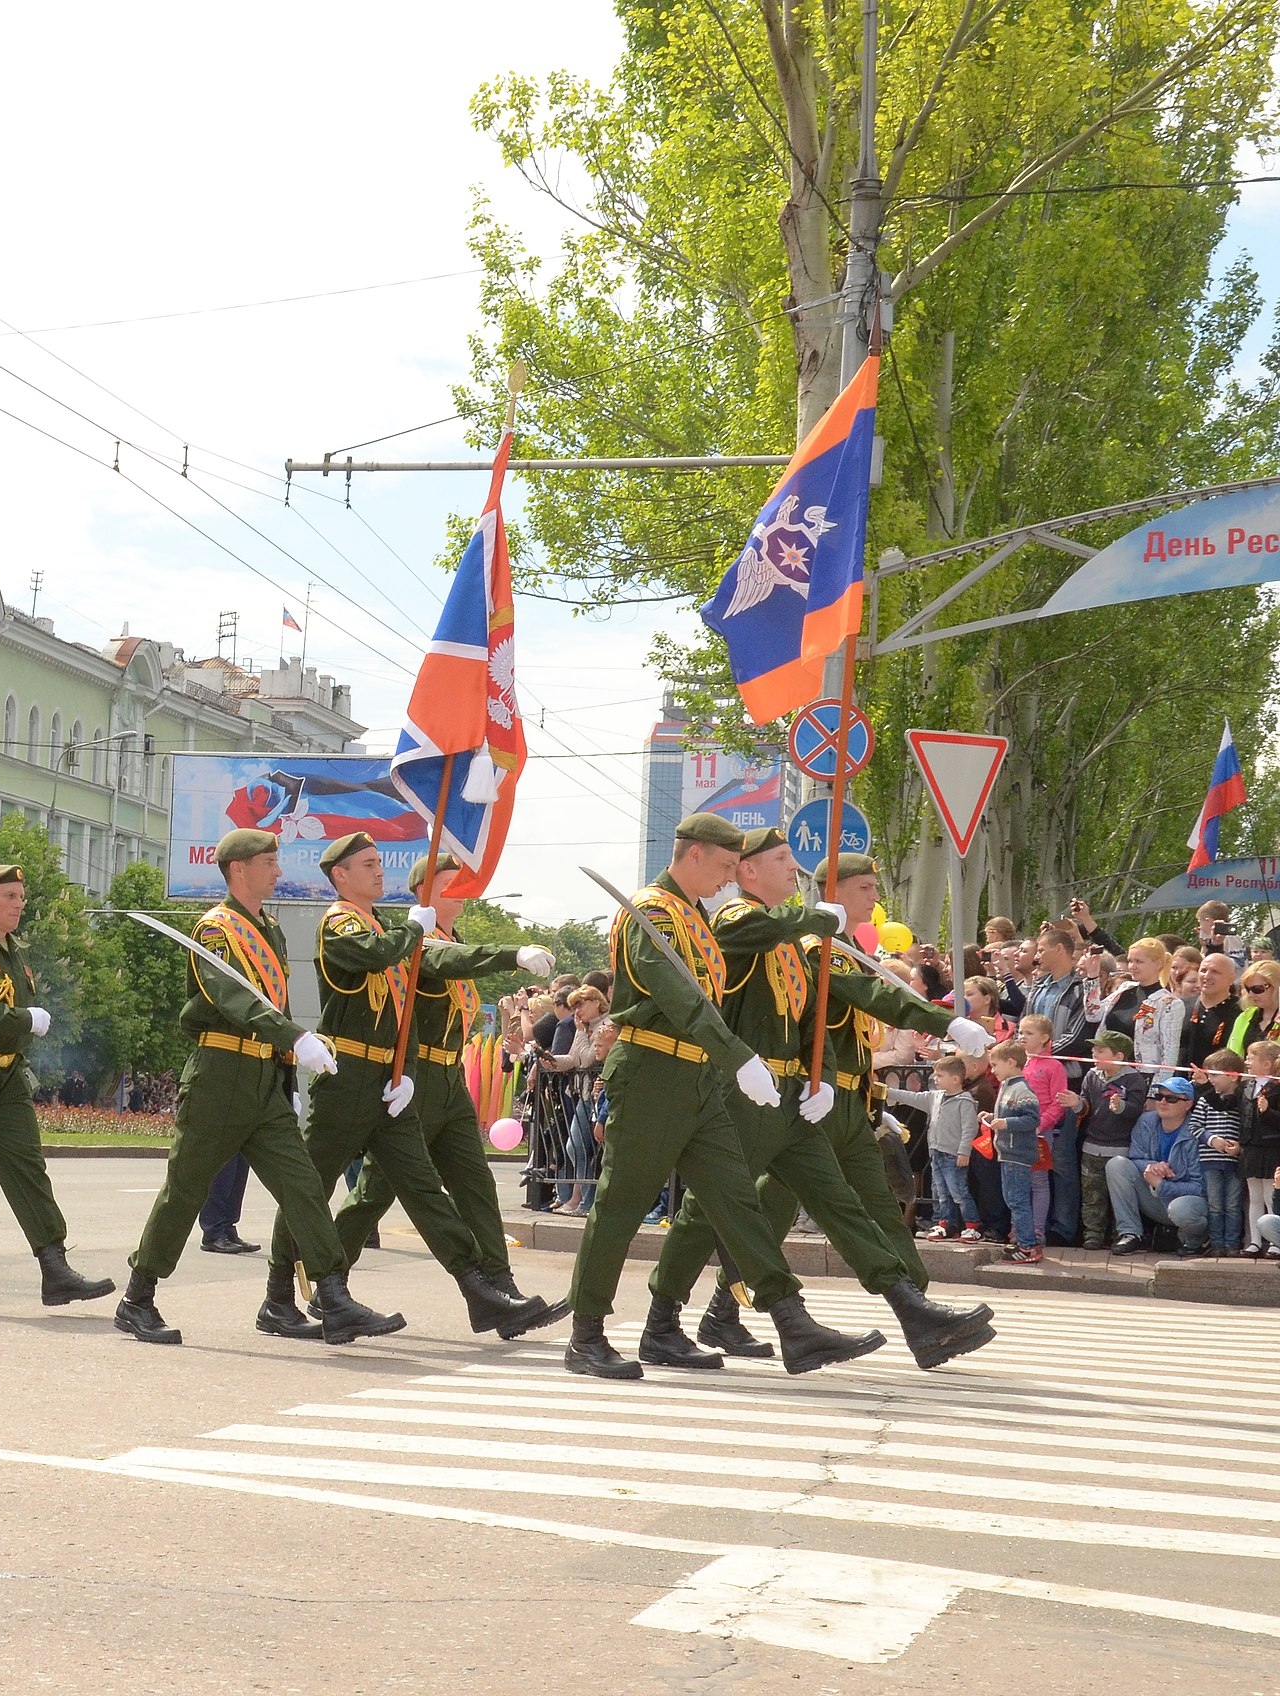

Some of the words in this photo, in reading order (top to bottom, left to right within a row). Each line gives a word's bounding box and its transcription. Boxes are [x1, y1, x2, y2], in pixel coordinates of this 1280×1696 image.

[1143, 531, 1216, 563] День
[1227, 527, 1280, 555] Рес
[691, 752, 717, 779] 11
[695, 779, 716, 789] мая
[732, 811, 765, 828] ДЕНЬ
[189, 846, 218, 865] ма
[1259, 857, 1276, 875] 11
[1187, 874, 1221, 889] День
